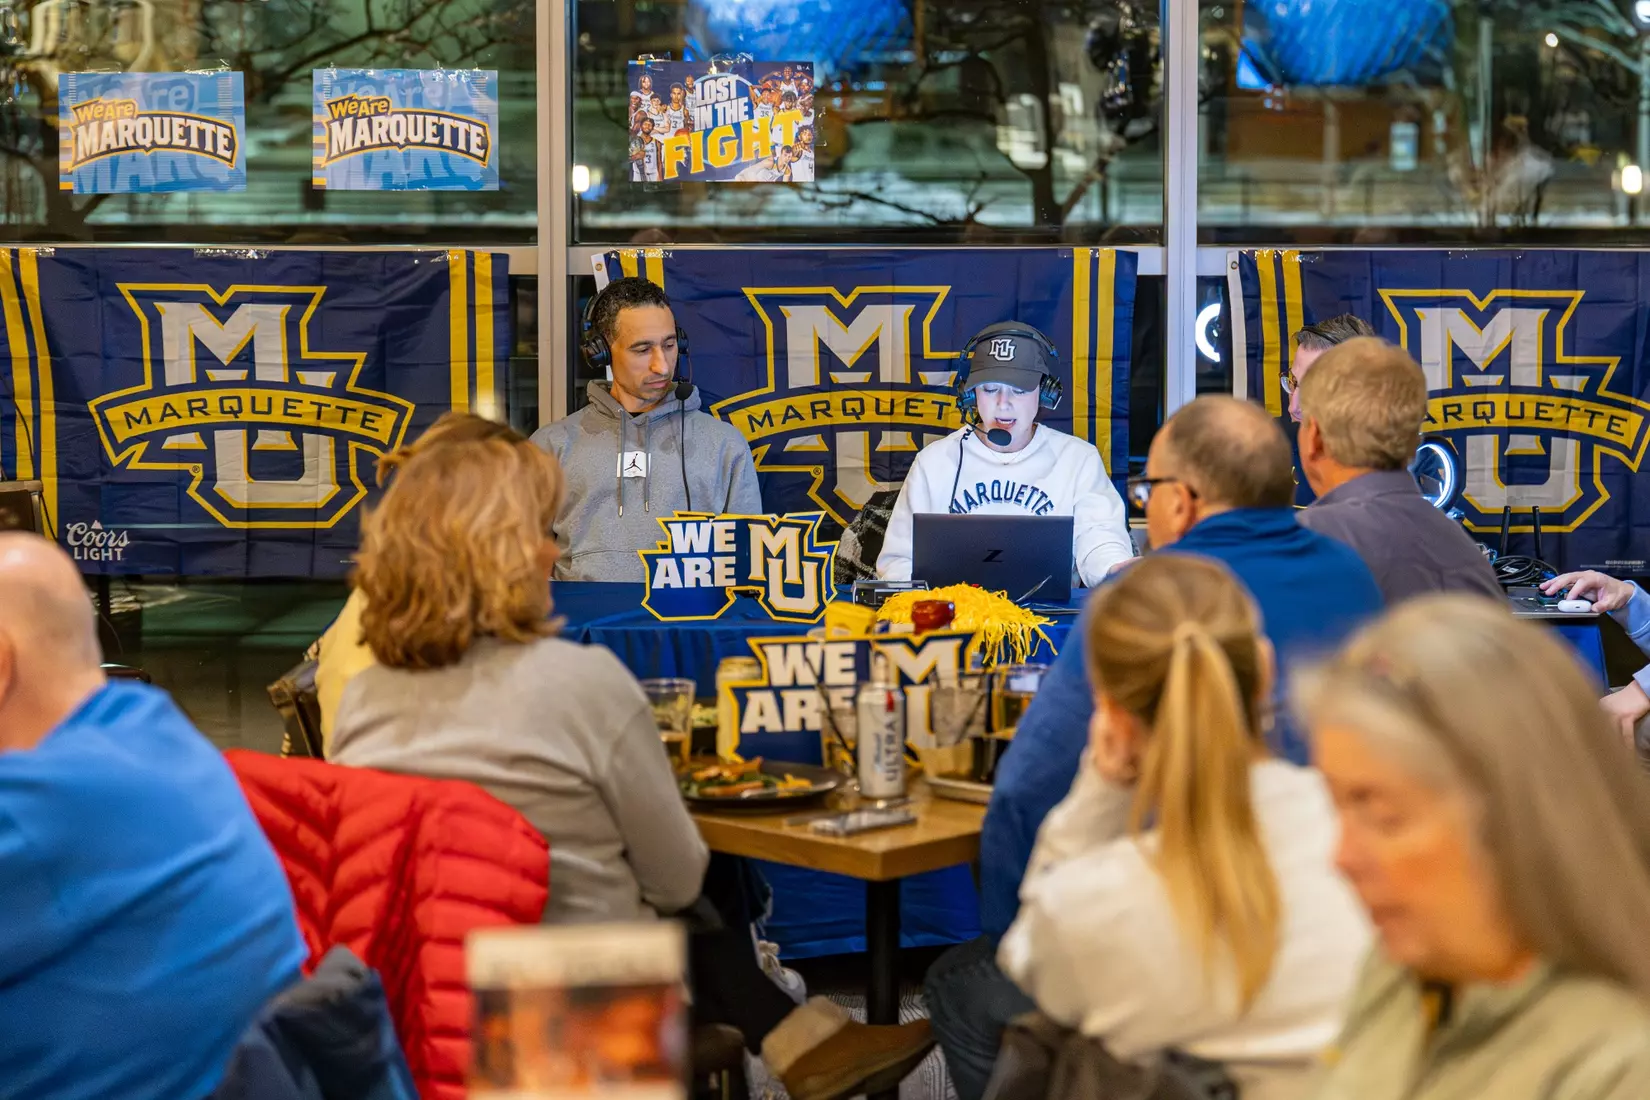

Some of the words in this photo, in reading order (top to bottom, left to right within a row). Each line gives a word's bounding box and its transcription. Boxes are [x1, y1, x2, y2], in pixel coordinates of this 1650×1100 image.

[695, 75, 739, 107] LOST
[694, 104, 714, 131] IN
[714, 97, 749, 126] THE
[77, 116, 233, 162] MARQUETTE
[330, 114, 486, 159] MARQUETTE
[663, 109, 804, 180] FIGHT
[988, 338, 1017, 363] MU
[124, 395, 387, 433] MARQUETTE
[747, 397, 967, 433] MARQUET
[1423, 400, 1629, 437] ARQUETTE
[949, 479, 1055, 516] MARQUETTE
[66, 522, 131, 548] Coors
[668, 521, 736, 554] WE
[74, 547, 124, 561] LIGHT
[652, 556, 736, 589] ARE
[748, 523, 820, 615] MU
[761, 641, 857, 687] WE
[884, 720, 899, 782] ULTRA
